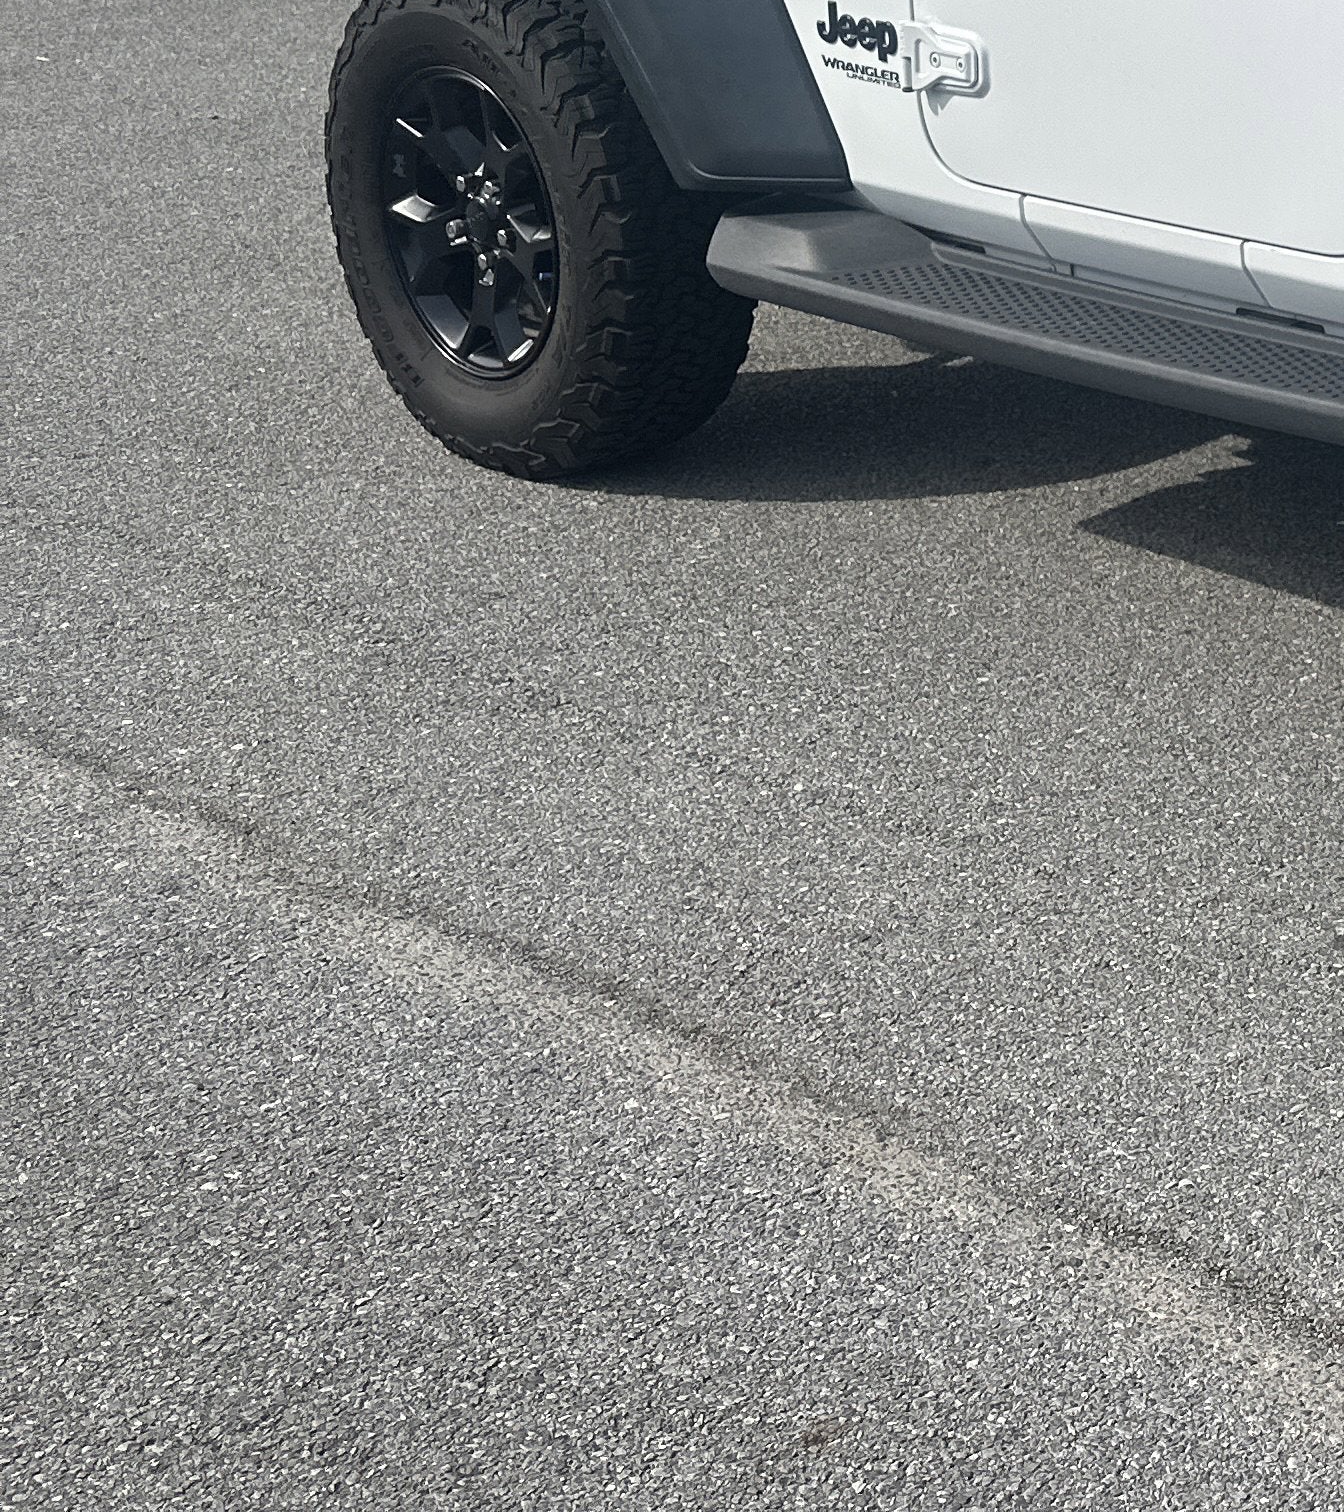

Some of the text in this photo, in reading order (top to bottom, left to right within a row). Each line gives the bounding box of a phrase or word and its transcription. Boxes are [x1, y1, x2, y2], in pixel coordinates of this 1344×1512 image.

[816, 0, 899, 64] Jeep
[821, 54, 900, 82] WRANGLER
[846, 71, 902, 89] UNLIMITED
